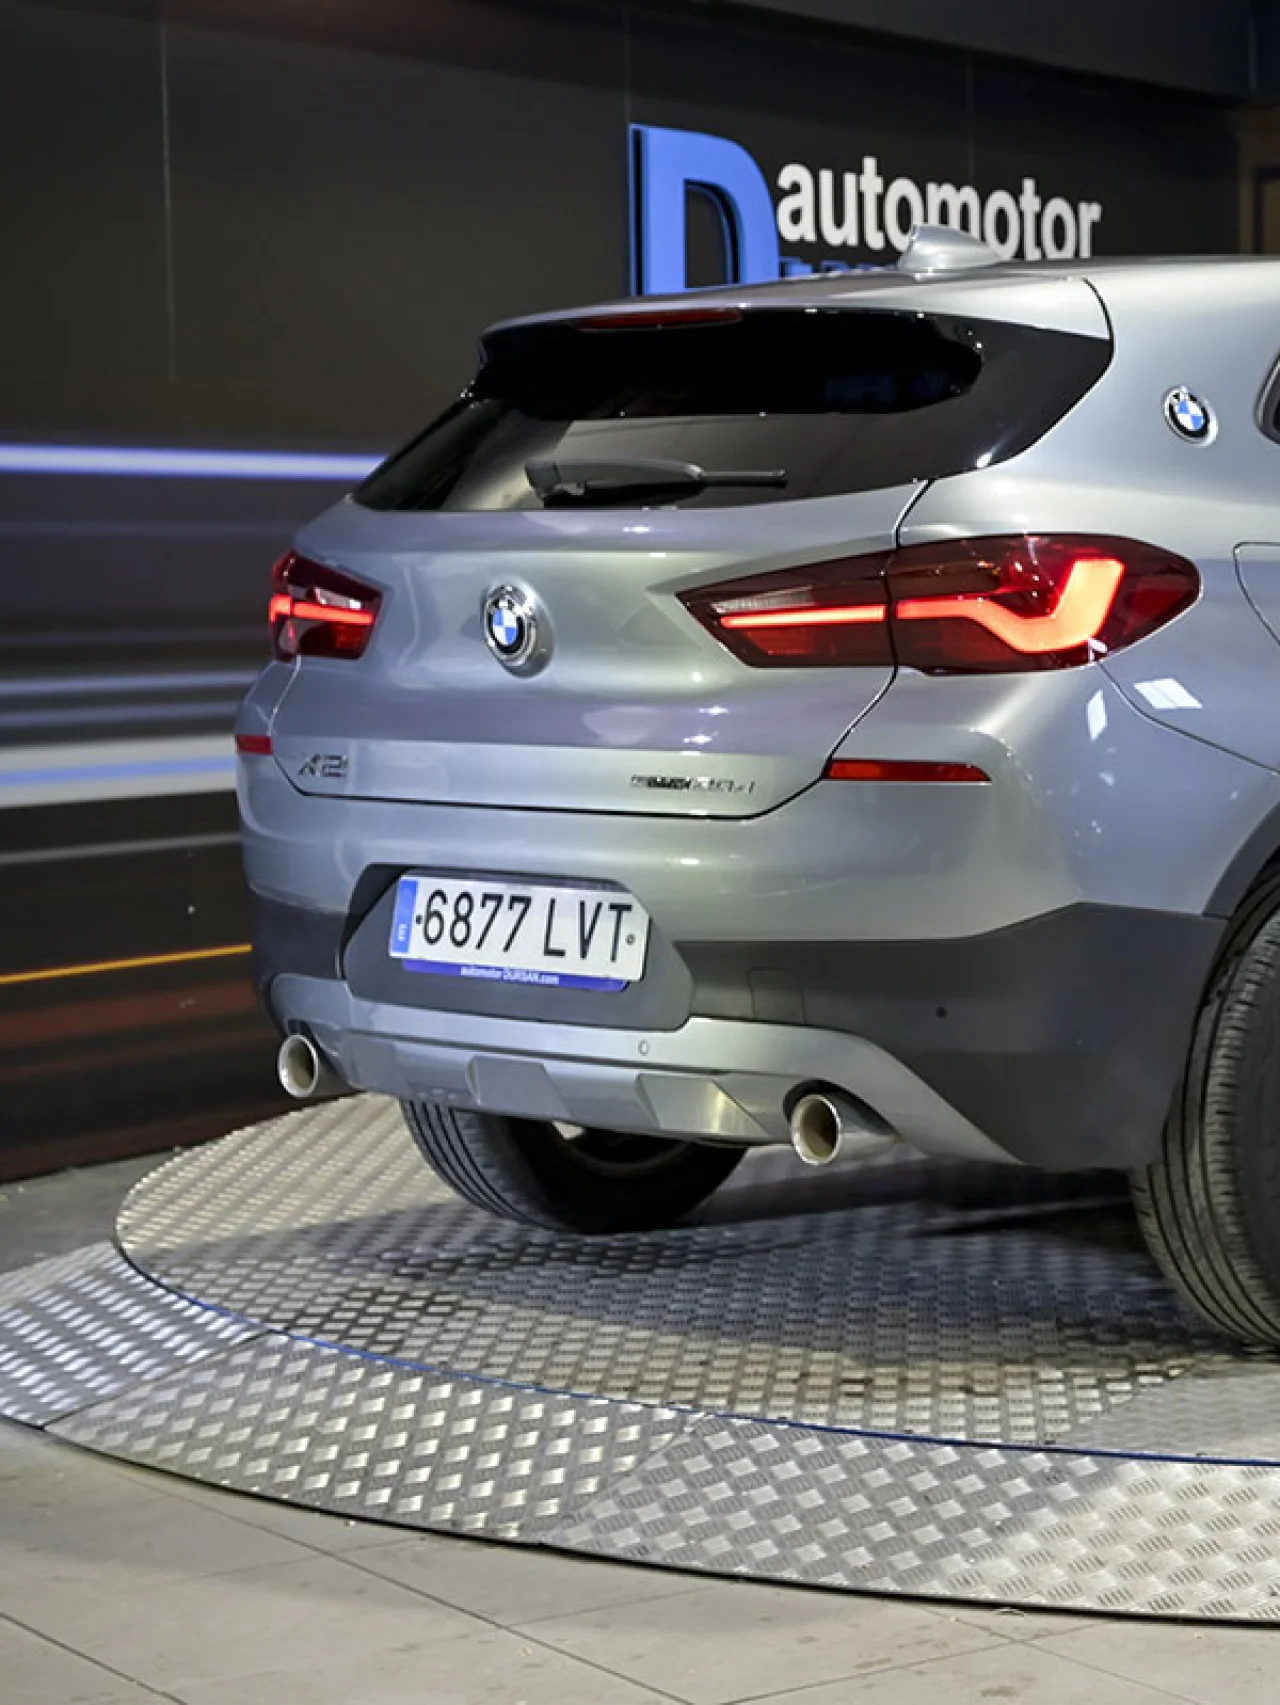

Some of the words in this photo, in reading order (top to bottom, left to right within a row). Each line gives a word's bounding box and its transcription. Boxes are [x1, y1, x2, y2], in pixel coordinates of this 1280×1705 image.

[776, 156, 1101, 260] automotor
[423, 889, 532, 953] 6877
[543, 897, 633, 962] LVT
